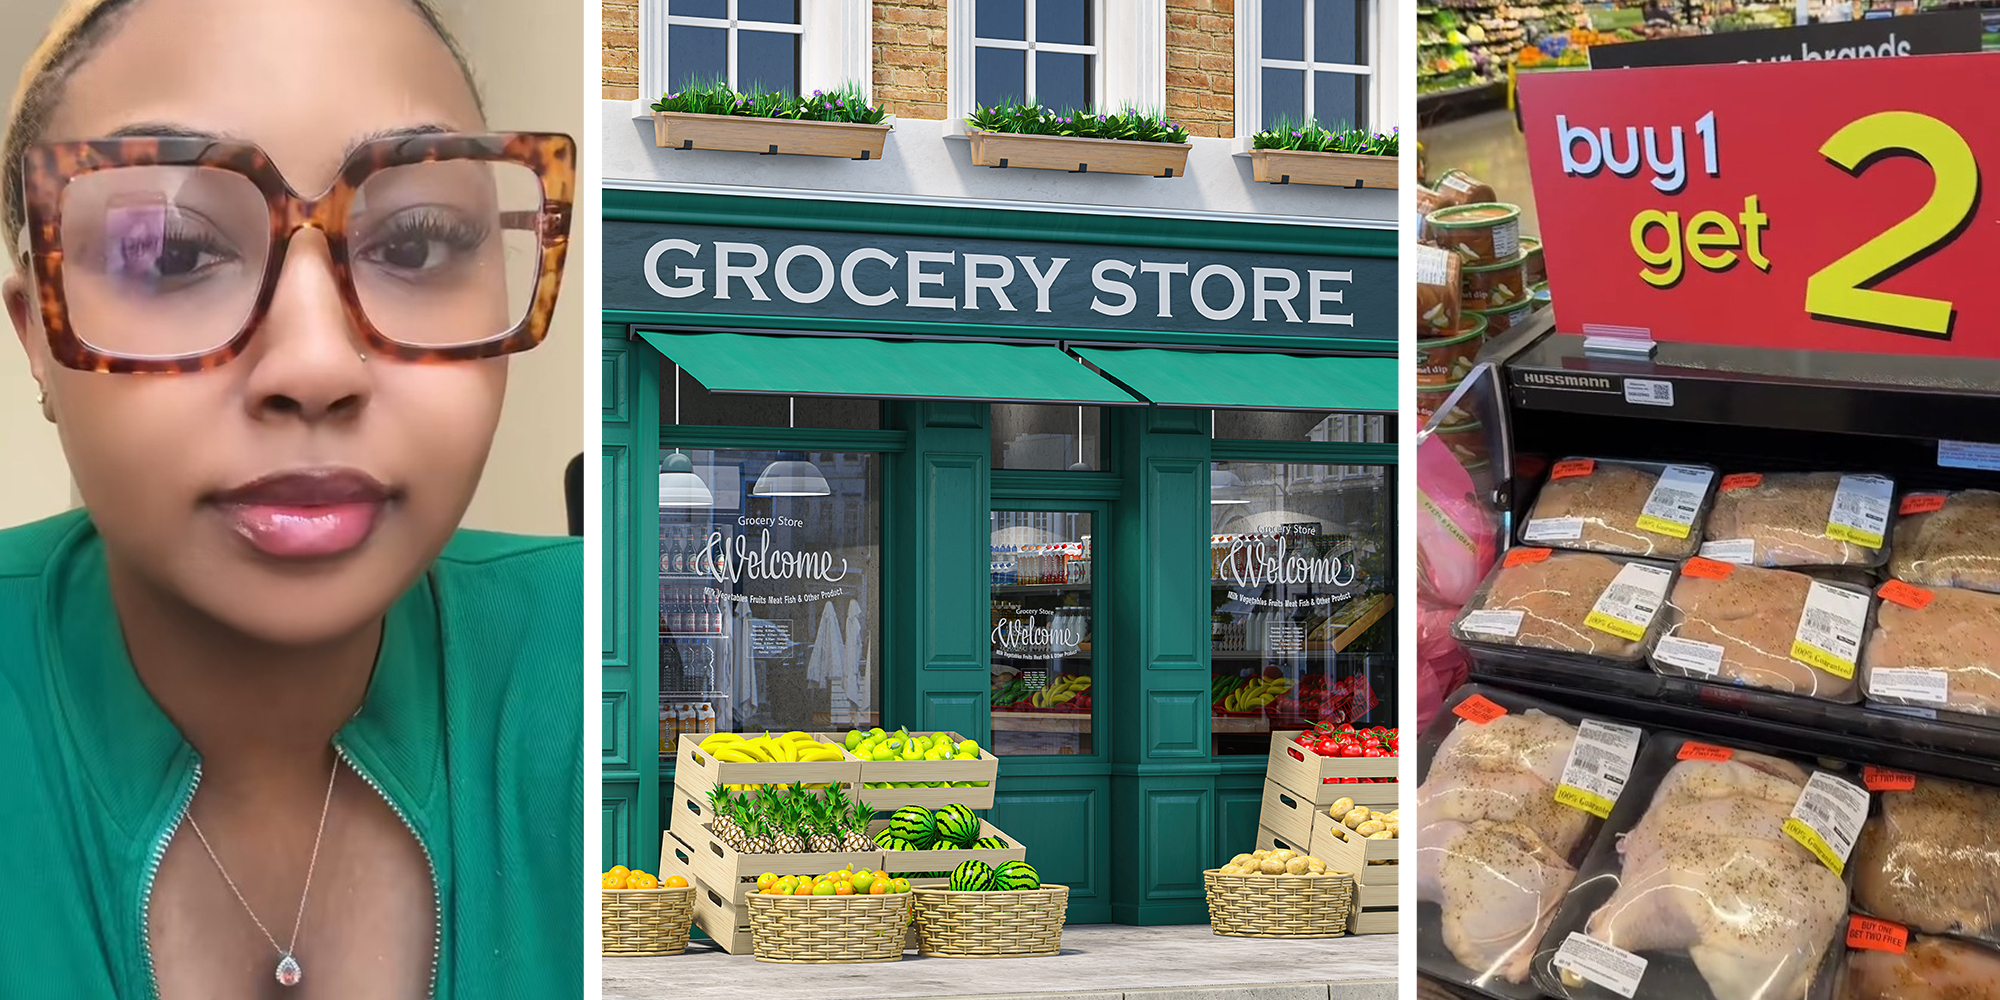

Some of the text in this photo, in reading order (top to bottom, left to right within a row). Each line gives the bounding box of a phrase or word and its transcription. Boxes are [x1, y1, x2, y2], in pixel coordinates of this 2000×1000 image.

[1556, 110, 1719, 192] buy 1
[1805, 110, 1979, 334] 2
[1629, 194, 1770, 288] get
[643, 238, 1071, 314] GROCERY
[1090, 259, 1354, 327] STORE
[1524, 372, 1610, 389] HUSSMANN
[738, 515, 804, 528] Grocery Store
[1257, 524, 1316, 536] Grocery Store
[695, 528, 848, 584] Welcome
[1220, 535, 1355, 588] Welcome
[749, 595, 766, 604] Fruits
[784, 595, 796, 604] Fish
[798, 595, 802, 603] &
[804, 593, 820, 603] Other
[821, 587, 843, 600] Product
[1268, 598, 1284, 607] Fruits
[1299, 599, 1310, 607] Fish
[1311, 598, 1315, 606] &
[1316, 596, 1331, 606] Other
[1331, 591, 1352, 603] Product
[991, 615, 1080, 648] Welcome
[1607, 621, 1642, 638] Guaranteed
[1794, 644, 1852, 676] 100% Guaranteed
[1865, 774, 1913, 783] GET TWO FREE
[1559, 789, 1578, 803] 100%
[1786, 822, 1842, 874] 100% Guaranteed
[1849, 928, 1903, 948] GET TWO FREE
[1861, 921, 1894, 935] BUY ONE
